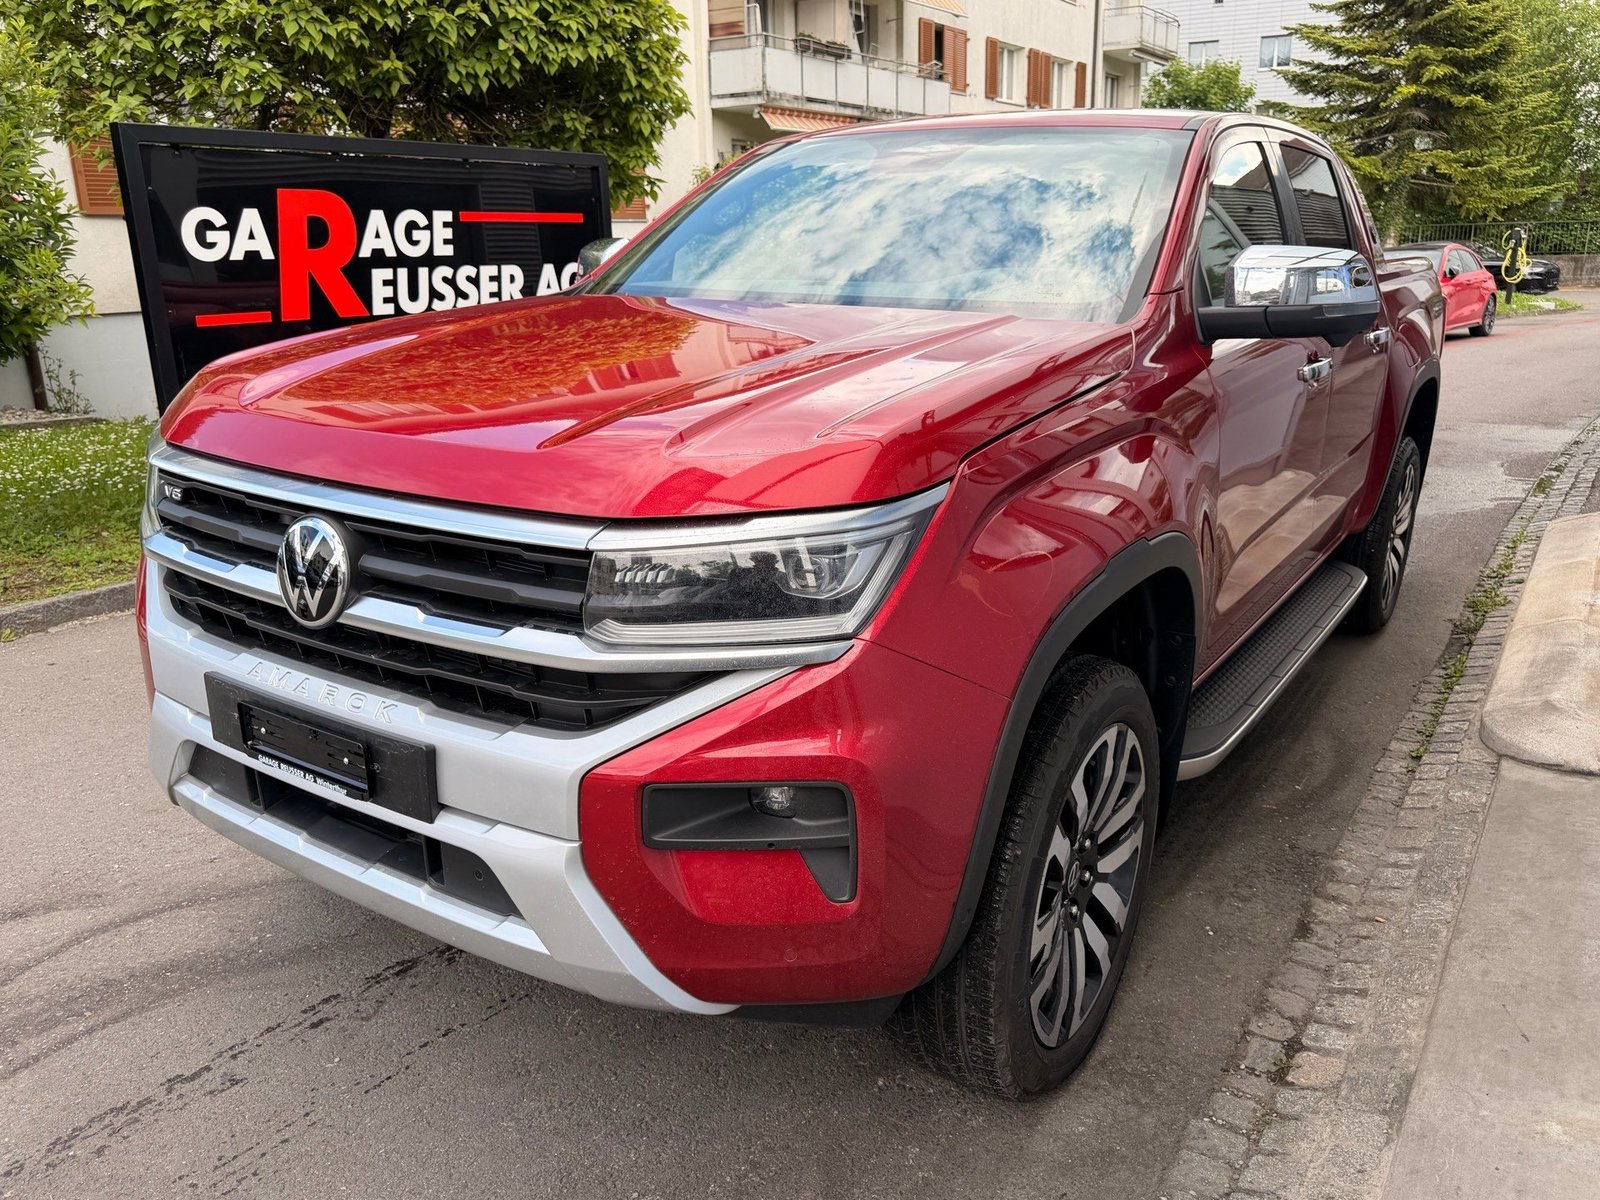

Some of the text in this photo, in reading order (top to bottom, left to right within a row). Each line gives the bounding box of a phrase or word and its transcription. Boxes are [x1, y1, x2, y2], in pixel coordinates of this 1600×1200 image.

[180, 188, 454, 321] GARAGE
[164, 485, 183, 500] V6
[246, 661, 398, 723] AMAROK
[258, 754, 279, 769] GARAGE
[305, 773, 315, 782] AG
[315, 777, 347, 795] Winterthur
